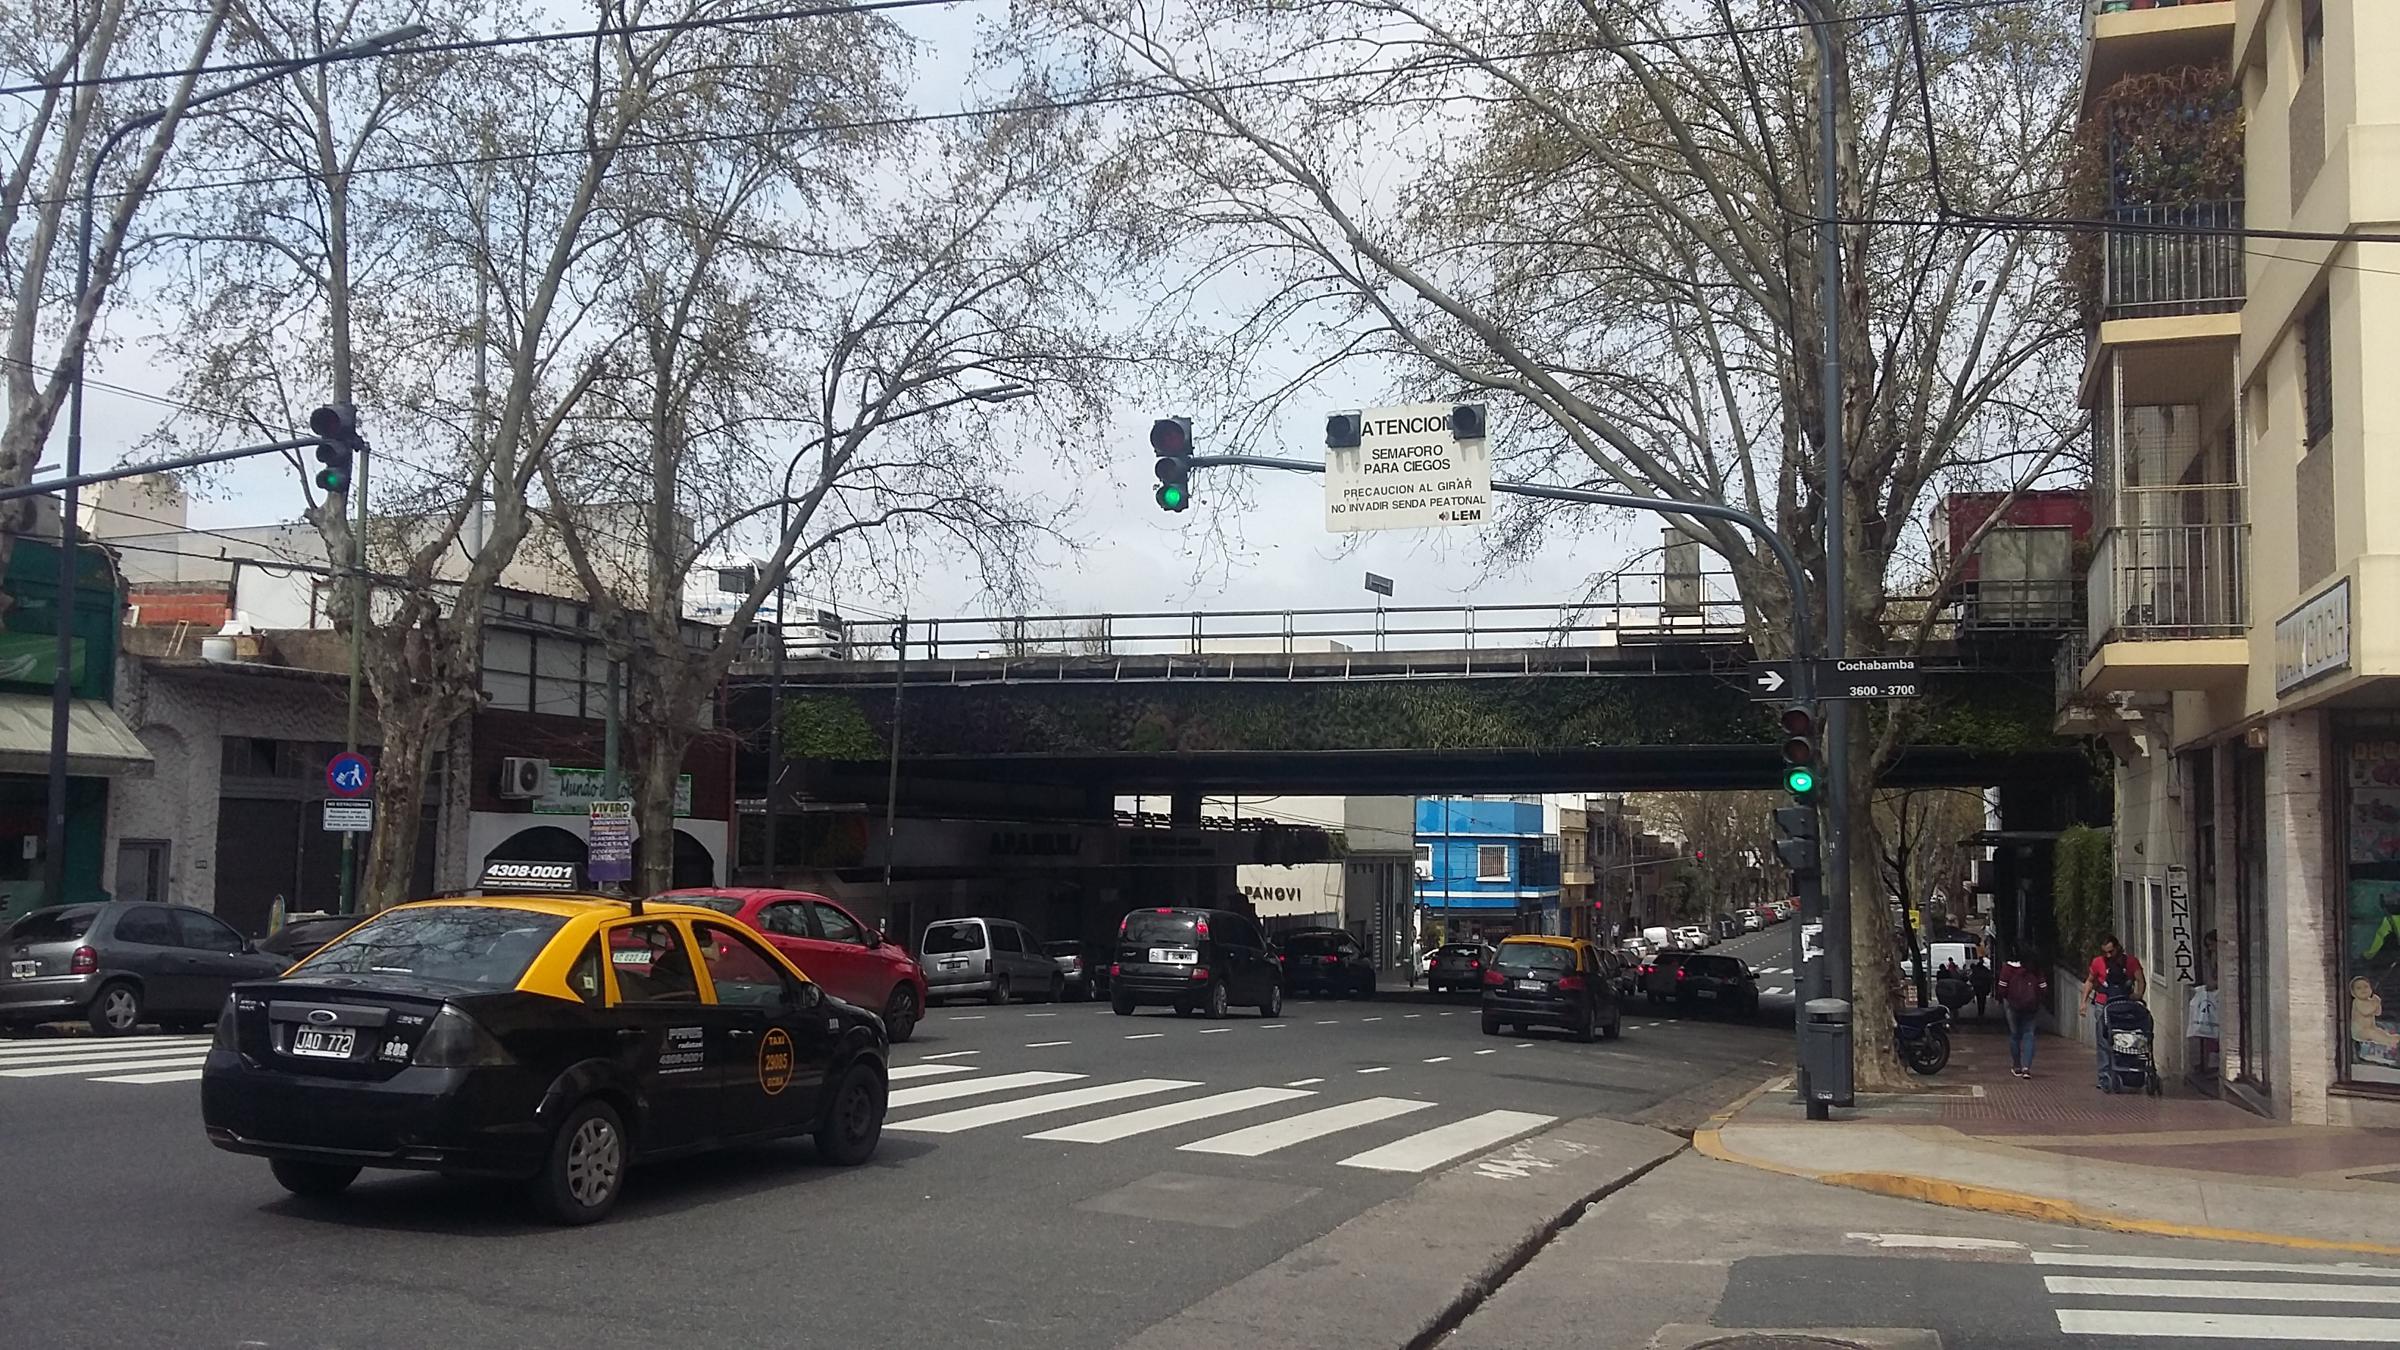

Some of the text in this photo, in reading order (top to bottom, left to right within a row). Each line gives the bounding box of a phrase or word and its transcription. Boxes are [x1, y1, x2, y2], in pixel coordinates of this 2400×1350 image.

[1372, 445, 1443, 460] SEMAFORO
[1364, 458, 1451, 475] PARA CIEGOS
[1343, 479, 1472, 498] PRECAUCION AL GIRAR
[1331, 495, 1487, 514] NO INVADIR SENDA PEATONAL
[1451, 510, 1481, 521] LEM
[1837, 660, 1915, 672] Cochabamba
[1849, 685, 1878, 697] 3600
[1887, 684, 1915, 696] 3700
[560, 776, 599, 798] Mundo
[591, 803, 630, 813] VIVERO
[487, 864, 572, 878] 4308-0001
[2169, 885, 2194, 982] ENTRADA
[326, 1036, 351, 1052] 772
[768, 1036, 785, 1046] TAXI
